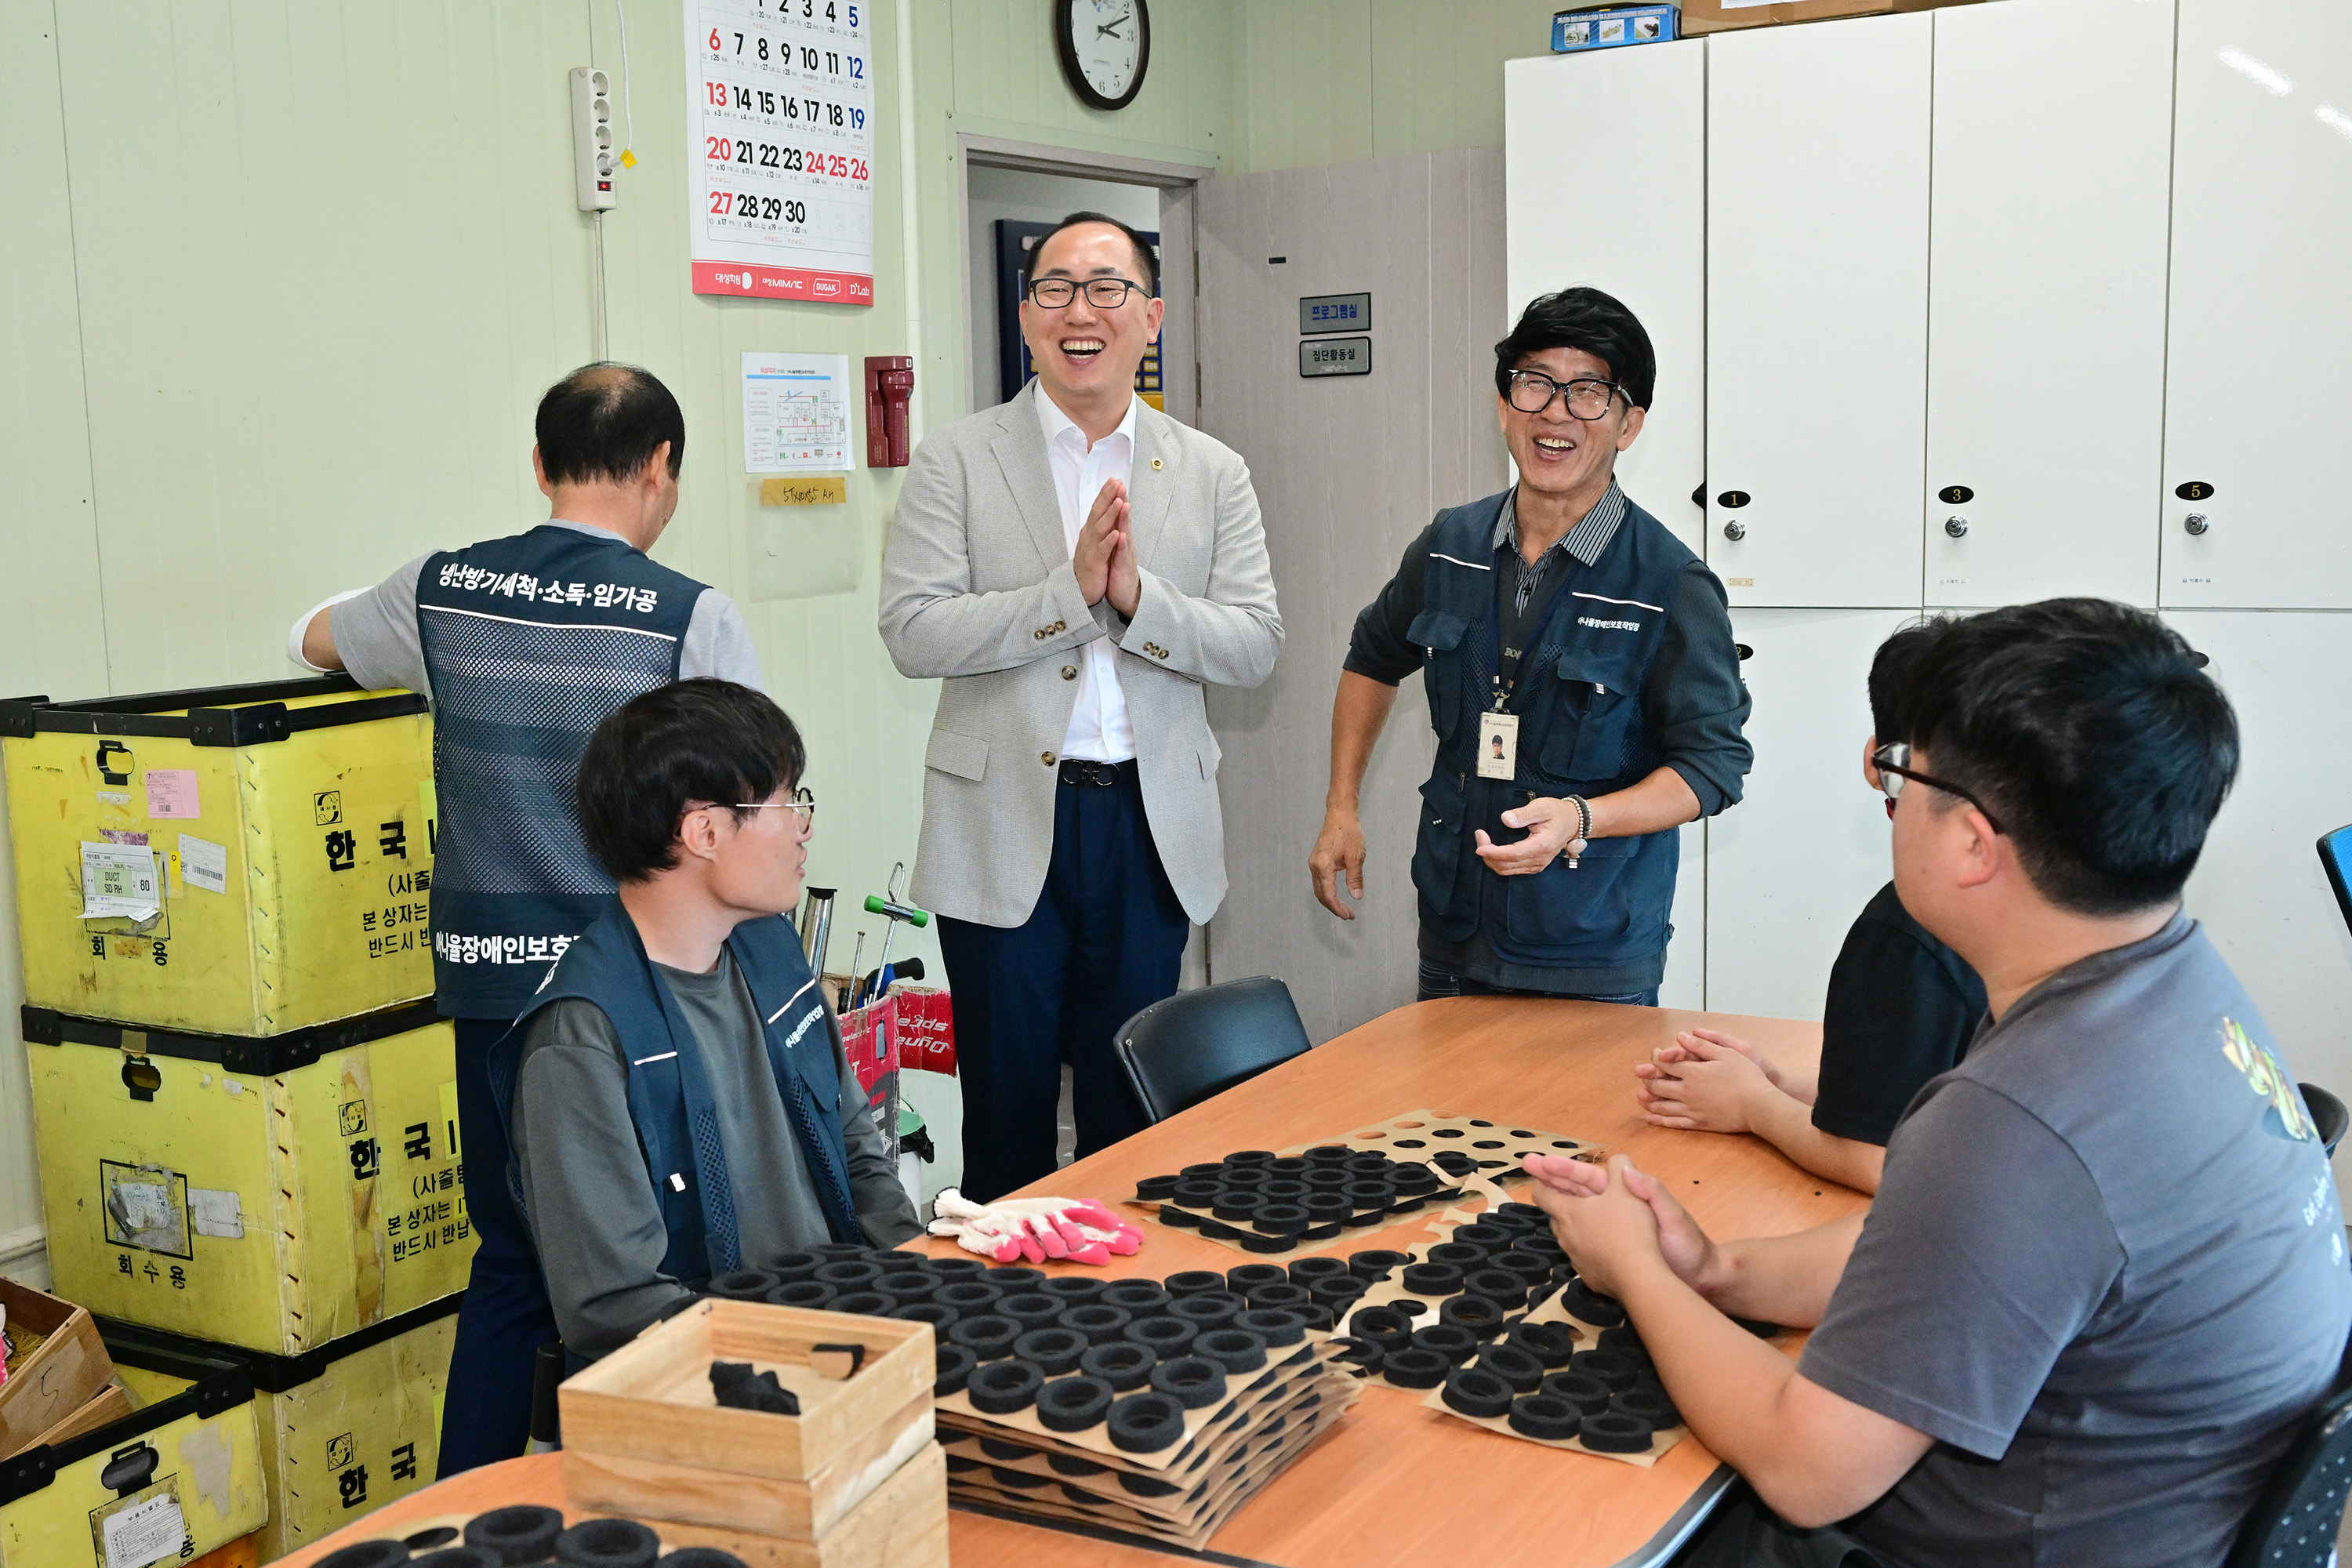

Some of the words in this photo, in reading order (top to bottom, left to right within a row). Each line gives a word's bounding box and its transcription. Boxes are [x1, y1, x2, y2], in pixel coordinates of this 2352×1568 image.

[803, 0, 812, 17] 3
[826, 1, 837, 23] 4
[848, 6, 858, 27] 5
[709, 28, 721, 51] 6
[734, 32, 744, 55] 7
[757, 38, 769, 60] 8
[781, 42, 791, 65] 9
[800, 46, 818, 71] 10
[826, 51, 839, 75] 11
[847, 56, 864, 80] 12
[706, 82, 727, 107] 13
[733, 85, 752, 111] 14
[757, 90, 775, 115] 15
[780, 95, 798, 119] 16
[804, 99, 820, 122] 17
[826, 103, 844, 127] 18
[848, 107, 866, 130] 19
[706, 136, 731, 162] 20
[736, 140, 753, 165] 21
[759, 144, 780, 169] 22
[782, 147, 803, 172] 23
[806, 151, 826, 175] 24
[828, 154, 848, 178] 25
[851, 158, 869, 181] 26
[710, 191, 733, 215] 27
[737, 194, 759, 219] 28
[761, 197, 782, 220] 29
[785, 200, 806, 224] 30
[715, 273, 741, 285] 대성학원
[816, 282, 837, 292] DUGAK
[1312, 303, 1357, 321] 프로그램실
[1312, 348, 1356, 362] 집단활동실
[1731, 494, 1738, 506] 1
[1953, 488, 1962, 502] 3
[2191, 485, 2201, 498] 5
[105, 872, 120, 882] DUCT
[140, 880, 150, 891] 80
[362, 911, 376, 932] 본
[383, 903, 427, 928] 상자는
[368, 931, 413, 959] 반드시
[387, 1214, 401, 1237] 본
[407, 1201, 451, 1230] 상자는
[393, 1229, 436, 1263] 반드시
